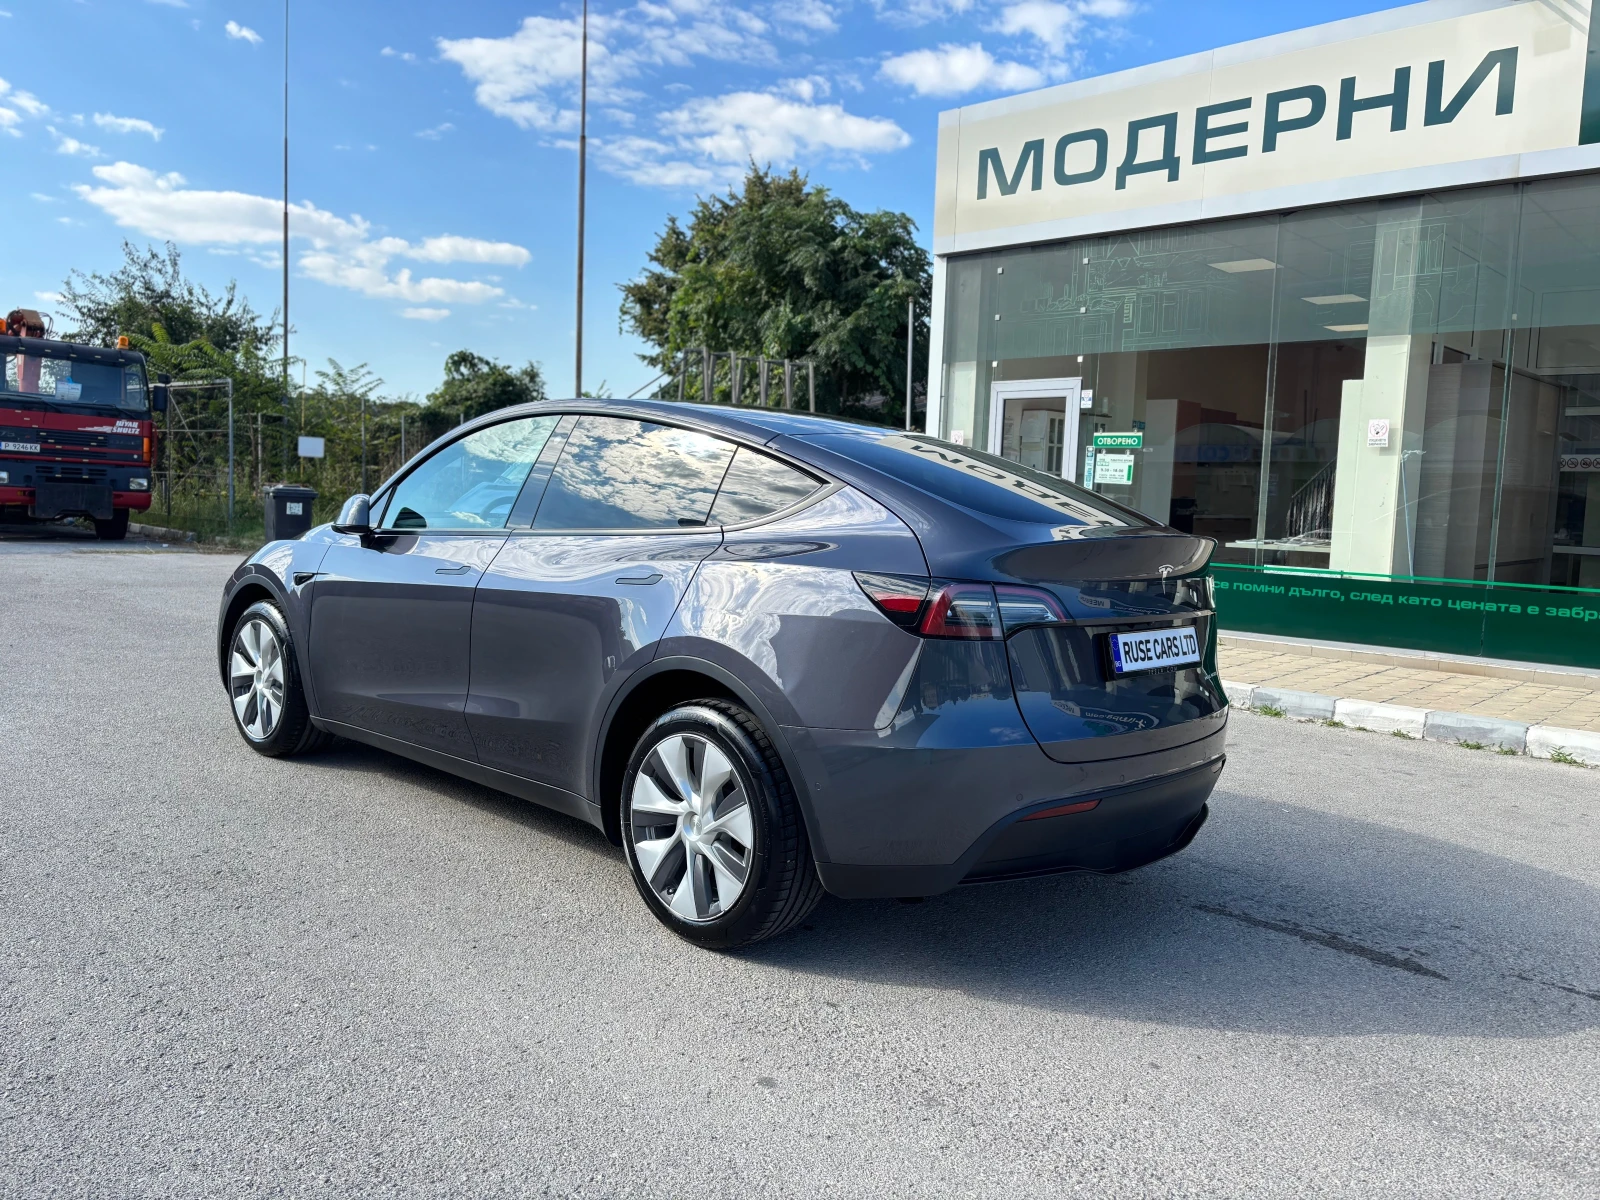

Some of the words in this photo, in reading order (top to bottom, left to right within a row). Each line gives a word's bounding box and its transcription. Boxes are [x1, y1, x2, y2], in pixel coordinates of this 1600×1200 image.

[977, 46, 1519, 200] МОДЕРНИ
[112, 426, 140, 435] SHULTZ
[13, 443, 29, 451] 9246
[1097, 437, 1138, 446] ОТВОРЕНО
[1233, 582, 1285, 595] помни
[1288, 586, 1345, 601] дълго,
[1350, 592, 1394, 605] след
[1398, 595, 1442, 607] като
[1448, 599, 1522, 614] цената
[1527, 605, 1540, 615] е
[1545, 606, 1600, 622] забр
[1122, 639, 1153, 664] RUSE
[1153, 636, 1180, 660] CARS
[1179, 634, 1197, 657] LTD
